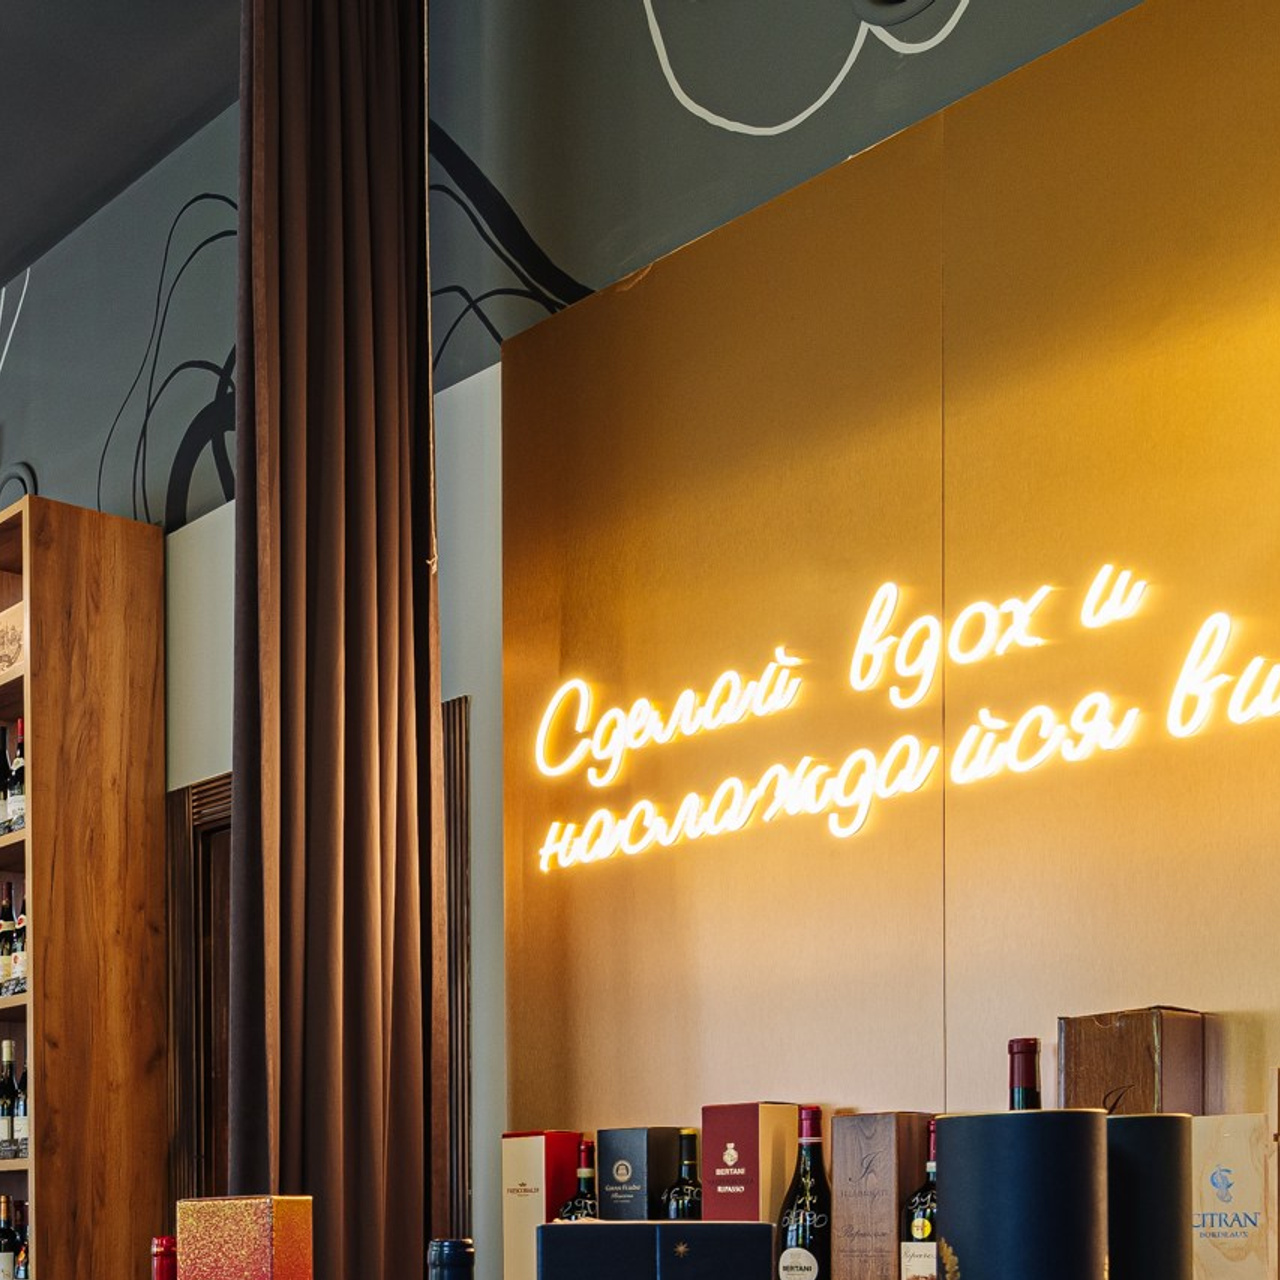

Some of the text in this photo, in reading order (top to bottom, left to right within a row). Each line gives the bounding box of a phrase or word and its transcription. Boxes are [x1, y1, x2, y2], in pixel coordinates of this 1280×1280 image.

[534, 563, 1150, 789] Сделай вдох и
[1166, 611, 1280, 739] ви
[715, 1167, 746, 1176] BERTANI
[716, 1185, 745, 1194] RIPASSO
[1191, 1212, 1260, 1229] CITRAN
[1199, 1231, 1249, 1239] BORDEAUX
